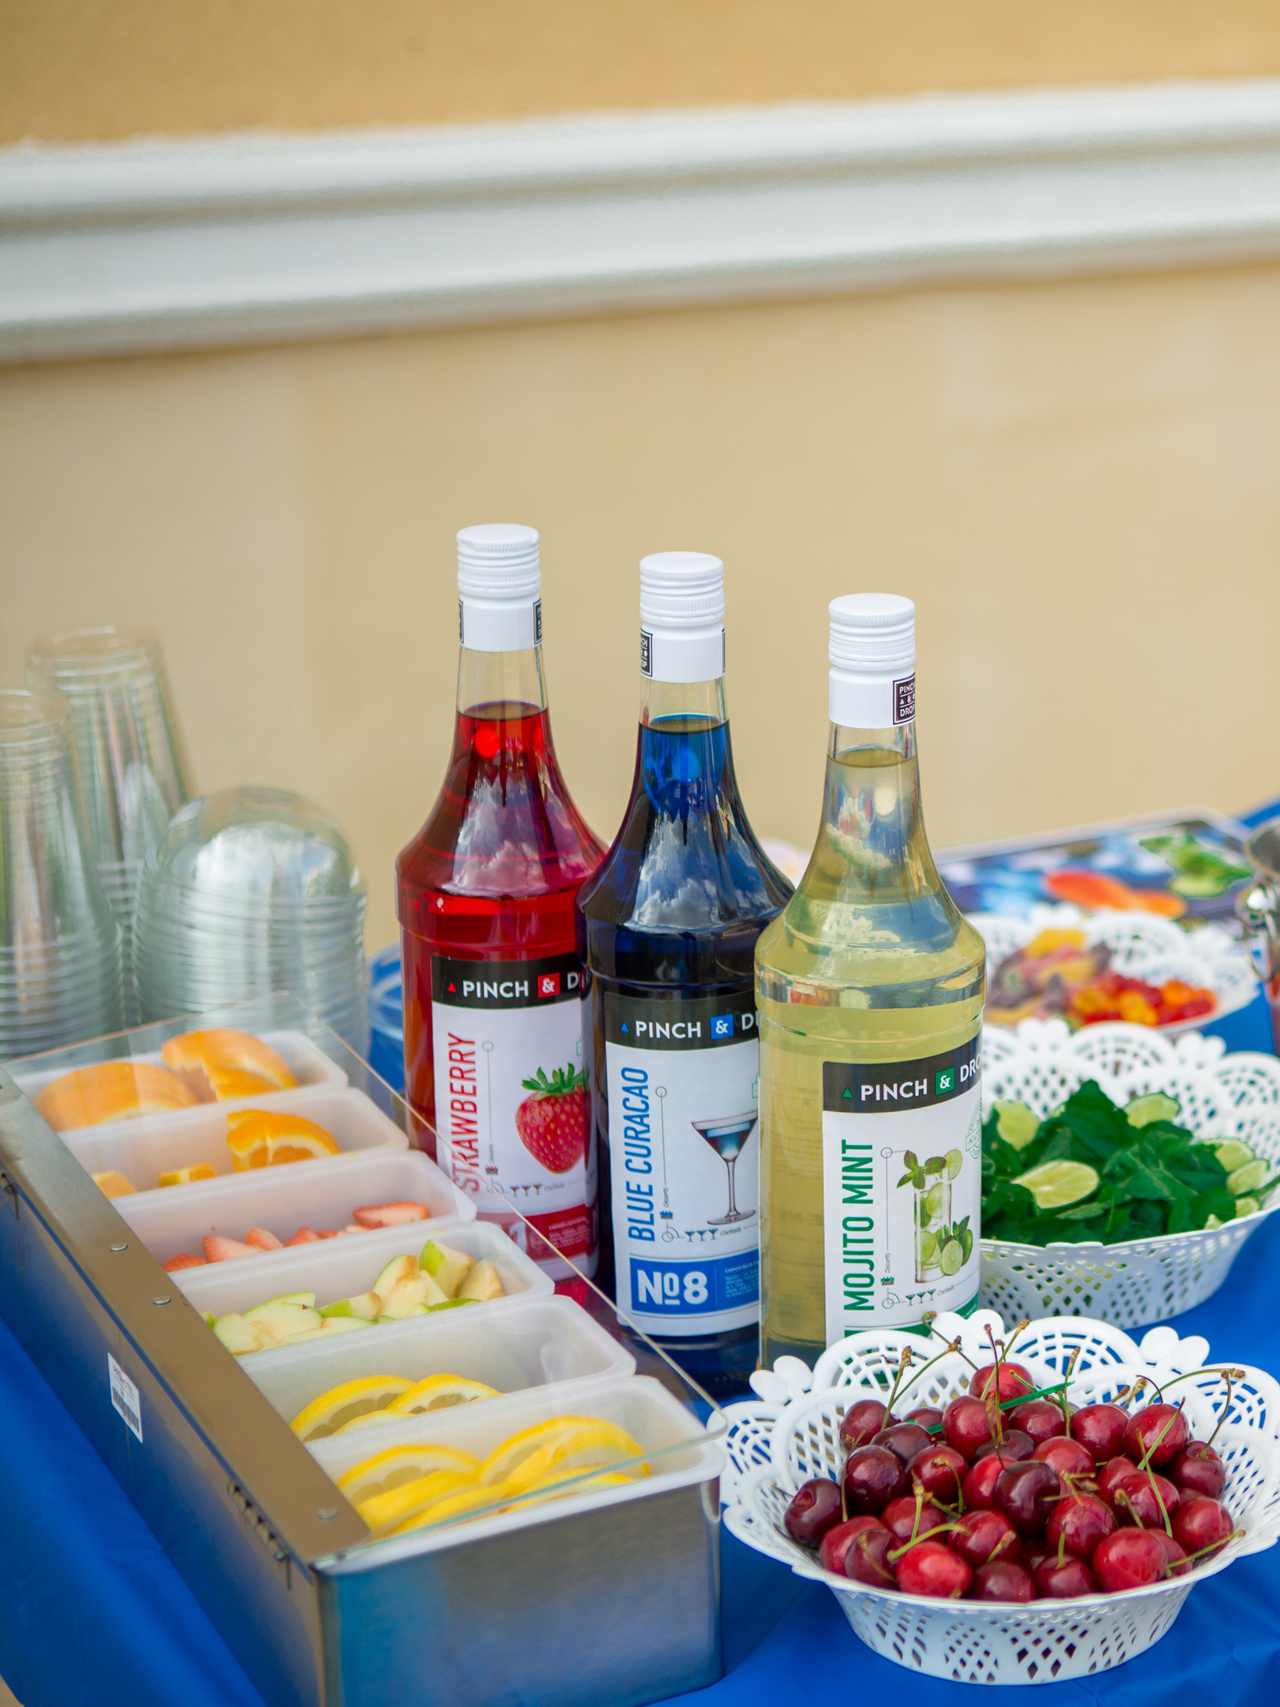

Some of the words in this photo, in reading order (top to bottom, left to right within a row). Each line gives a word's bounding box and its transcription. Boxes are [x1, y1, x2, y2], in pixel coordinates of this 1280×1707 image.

[899, 682, 915, 695] PINC
[462, 980, 529, 998] PINCH
[541, 977, 555, 993] &
[635, 1020, 702, 1039] PINCH
[715, 1019, 729, 1034] &
[447, 1031, 480, 1193] STRAWBERRY
[860, 1078, 928, 1101] PINCH
[939, 1074, 951, 1089] &
[620, 1066, 652, 1175] CURACAO
[841, 1139, 874, 1204] MINT
[625, 1180, 656, 1242] BLUE
[841, 1216, 875, 1311] MOJITO
